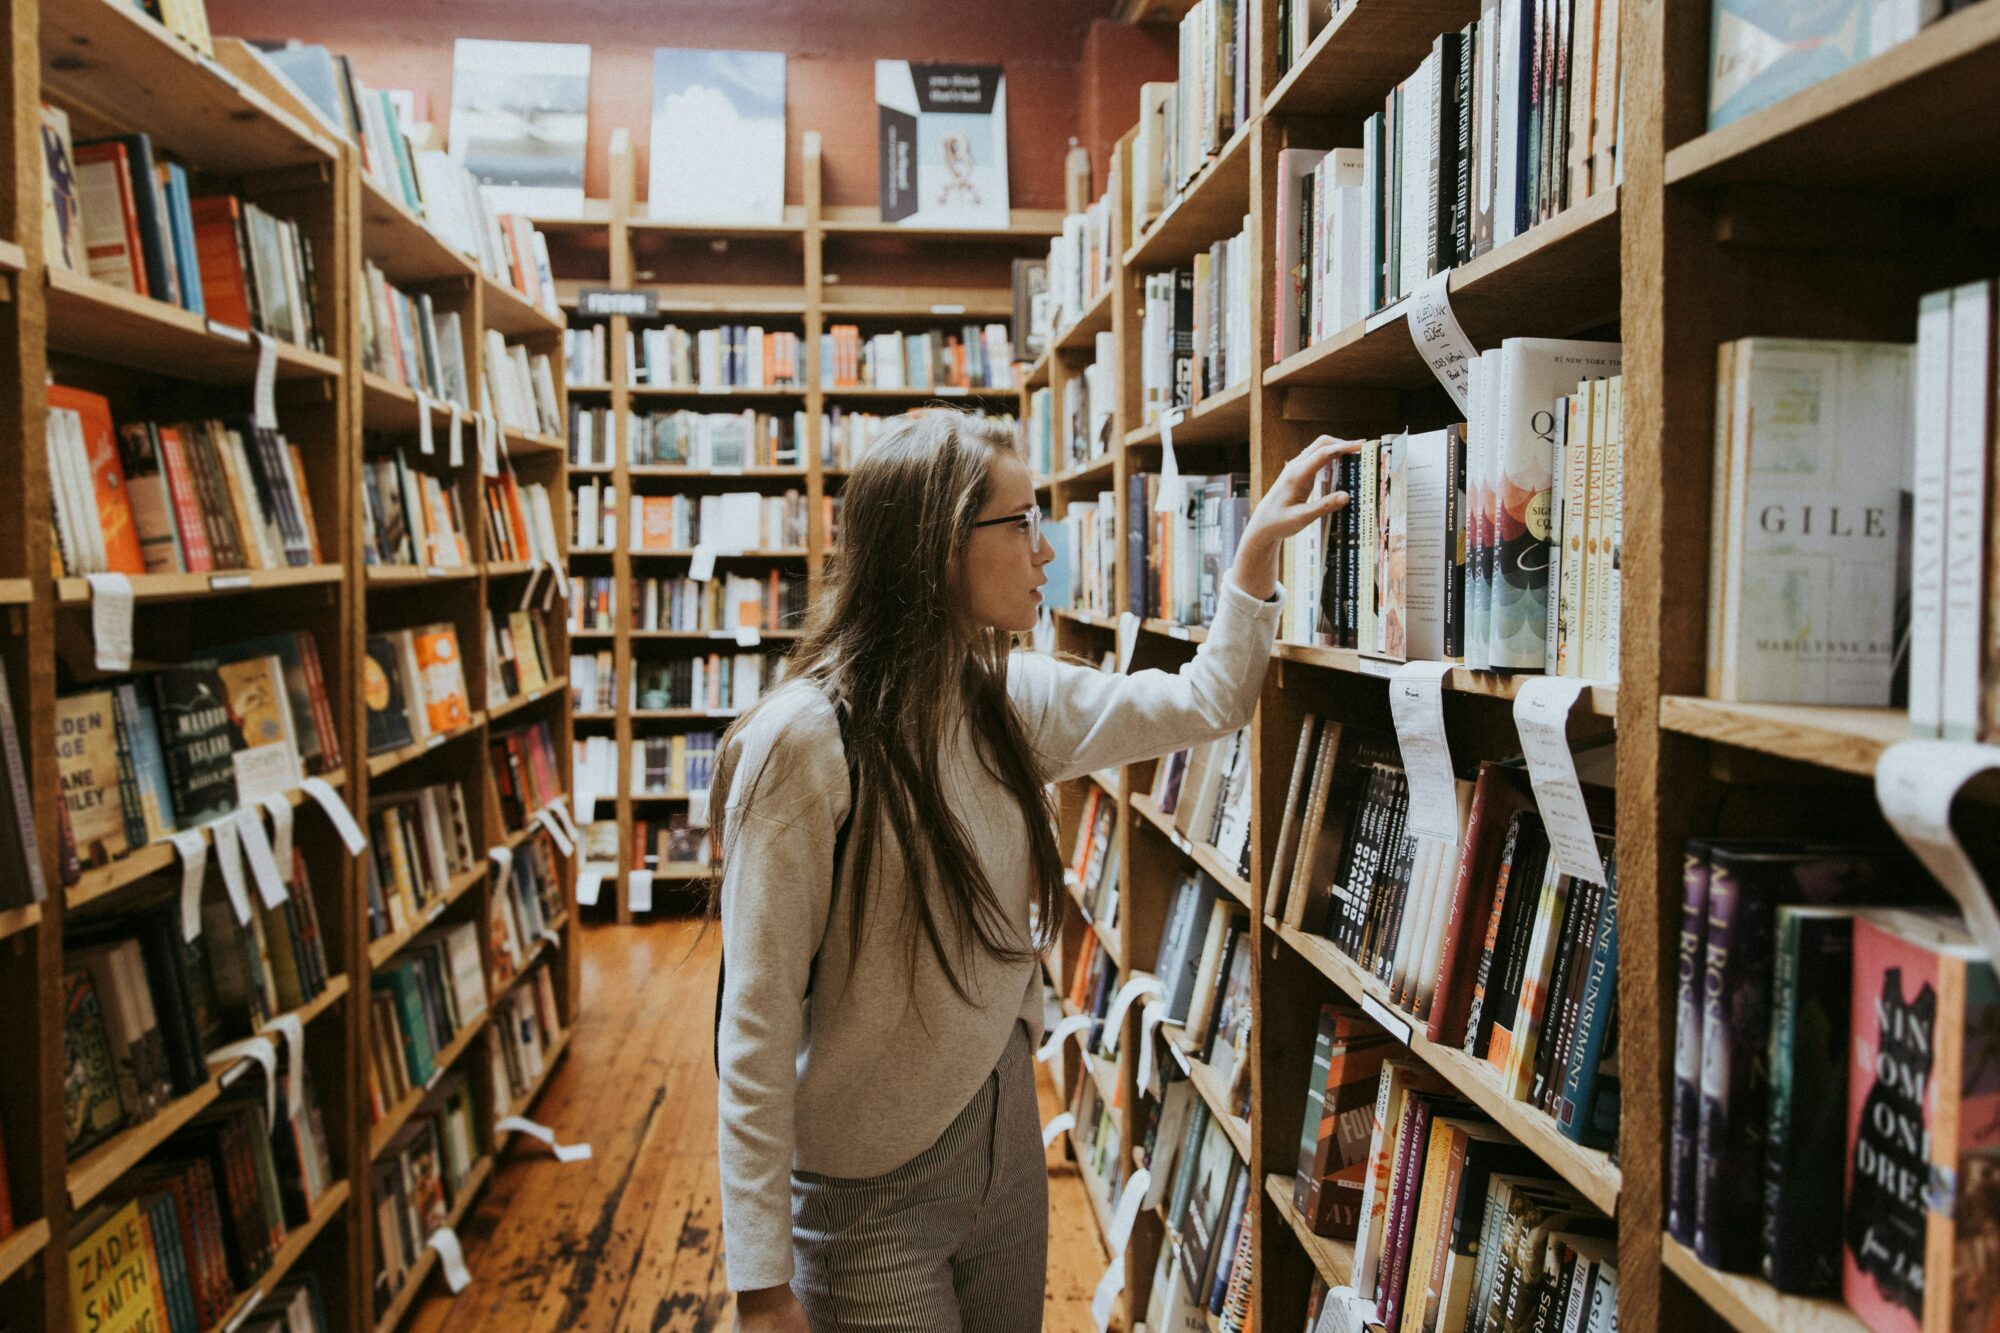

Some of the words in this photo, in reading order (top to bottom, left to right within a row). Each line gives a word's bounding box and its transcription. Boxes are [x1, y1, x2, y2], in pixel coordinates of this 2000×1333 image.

[1459, 39, 1470, 90] THOMAS
[1430, 102, 1440, 160] PYNCHON
[1458, 92, 1468, 151] PYNCHON
[1428, 168, 1438, 229] BLEEDING
[1456, 158, 1467, 219] BLEEDING
[1427, 230, 1437, 261] EDGE
[1456, 221, 1466, 253] EDGE
[1586, 358, 1607, 366] YORK
[1571, 444, 1585, 517] ISHMAEL
[1590, 446, 1602, 520] ISHMAEL
[1603, 443, 1616, 518] ISHMAEL
[1549, 560, 1557, 588] Anna
[1569, 559, 1578, 596] DANIEL
[1587, 562, 1595, 600] DANIEL
[1600, 561, 1609, 600] DANIEL
[1548, 590, 1556, 642] Quindlen
[1568, 597, 1577, 637] QUINN
[1585, 601, 1595, 641] QUINN
[1599, 602, 1608, 641] QUINN
[1465, 812, 1478, 851] Devil
[1462, 852, 1470, 865] in
[1349, 846, 1371, 921] OTARED
[1356, 850, 1378, 926] OTARED
[1448, 865, 1467, 925] Jerusalem
[1583, 888, 1592, 907] WHY
[1710, 864, 1729, 898] M
[1566, 898, 1578, 935] RAKHA
[1593, 892, 1601, 914] WHY
[1577, 919, 1586, 944] CAME
[1585, 924, 1595, 949] CAME
[1503, 958, 1514, 991] Childhood
[1511, 961, 1521, 996] Childhood
[1703, 942, 1727, 1034] ROSE
[1545, 973, 1563, 1041] CROCODILES
[1561, 997, 1570, 1023] MARY
[1568, 958, 1606, 1092] PUNISHMENT
[1570, 1002, 1579, 1030] MARY
[1392, 1116, 1409, 1191] UNRESTORED
[1402, 1125, 1421, 1201] UNRESTORED
[1445, 1186, 1453, 1205] RON
[1386, 1194, 1397, 1238] WOMAN
[1396, 1205, 1408, 1249] WOMAN
[1440, 1207, 1450, 1239] RASH
[1491, 1201, 1503, 1236] Ron
[1503, 1212, 1516, 1249] THE
[77, 1216, 141, 1294] ZADIE
[1432, 1239, 1445, 1281] READER
[1516, 1225, 1530, 1257] THE
[1493, 1251, 1508, 1306] RISEN
[1506, 1266, 1522, 1320] RISEN
[1573, 1263, 1586, 1286] THE
[85, 1256, 147, 1333] SMITH
[1565, 1286, 1581, 1331] WORLD
[1553, 1299, 1563, 1330] RASH
